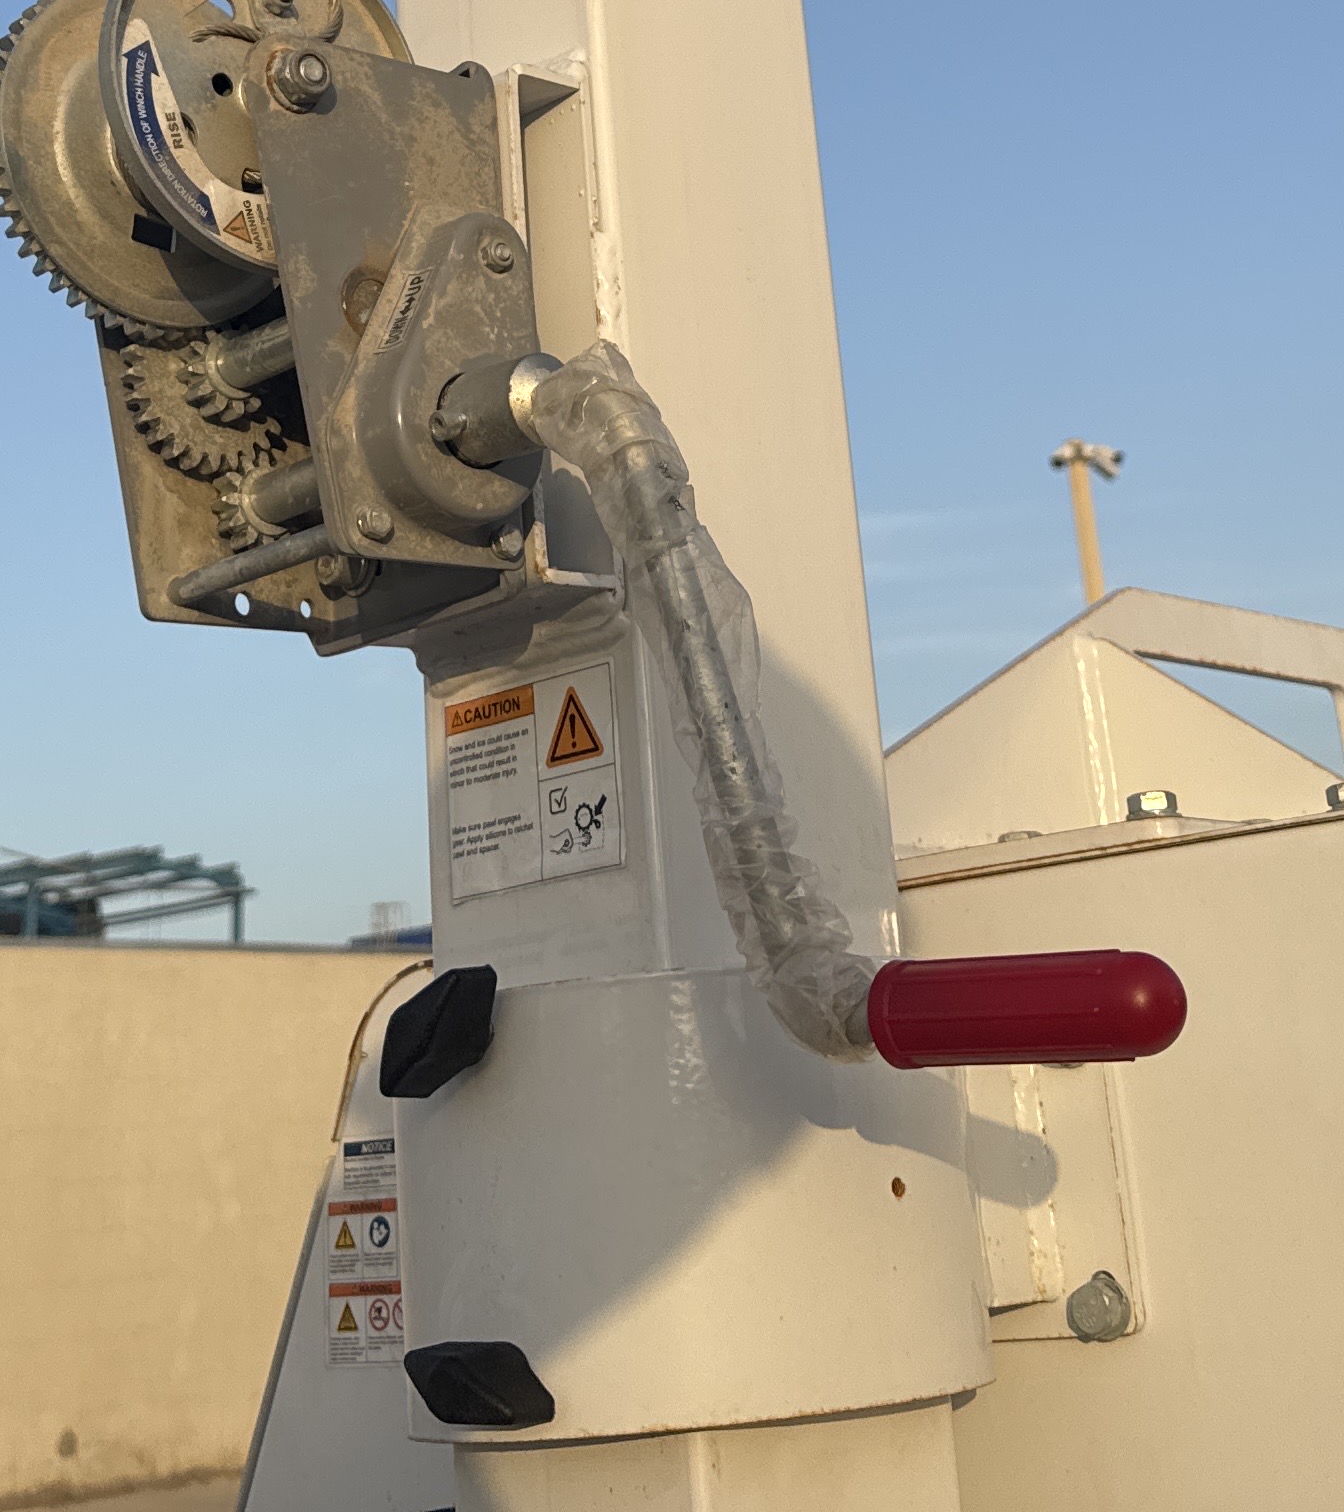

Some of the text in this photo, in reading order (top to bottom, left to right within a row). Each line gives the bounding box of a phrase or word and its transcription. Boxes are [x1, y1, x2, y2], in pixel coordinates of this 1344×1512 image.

[134, 50, 208, 217] ROTATION DIRECTION OF WINCH HANDLE
[164, 111, 185, 149] RISE
[243, 199, 264, 252] WARNING
[404, 276, 425, 298] UP
[463, 696, 521, 724] CAUTION
[360, 1140, 393, 1153] NOTICE
